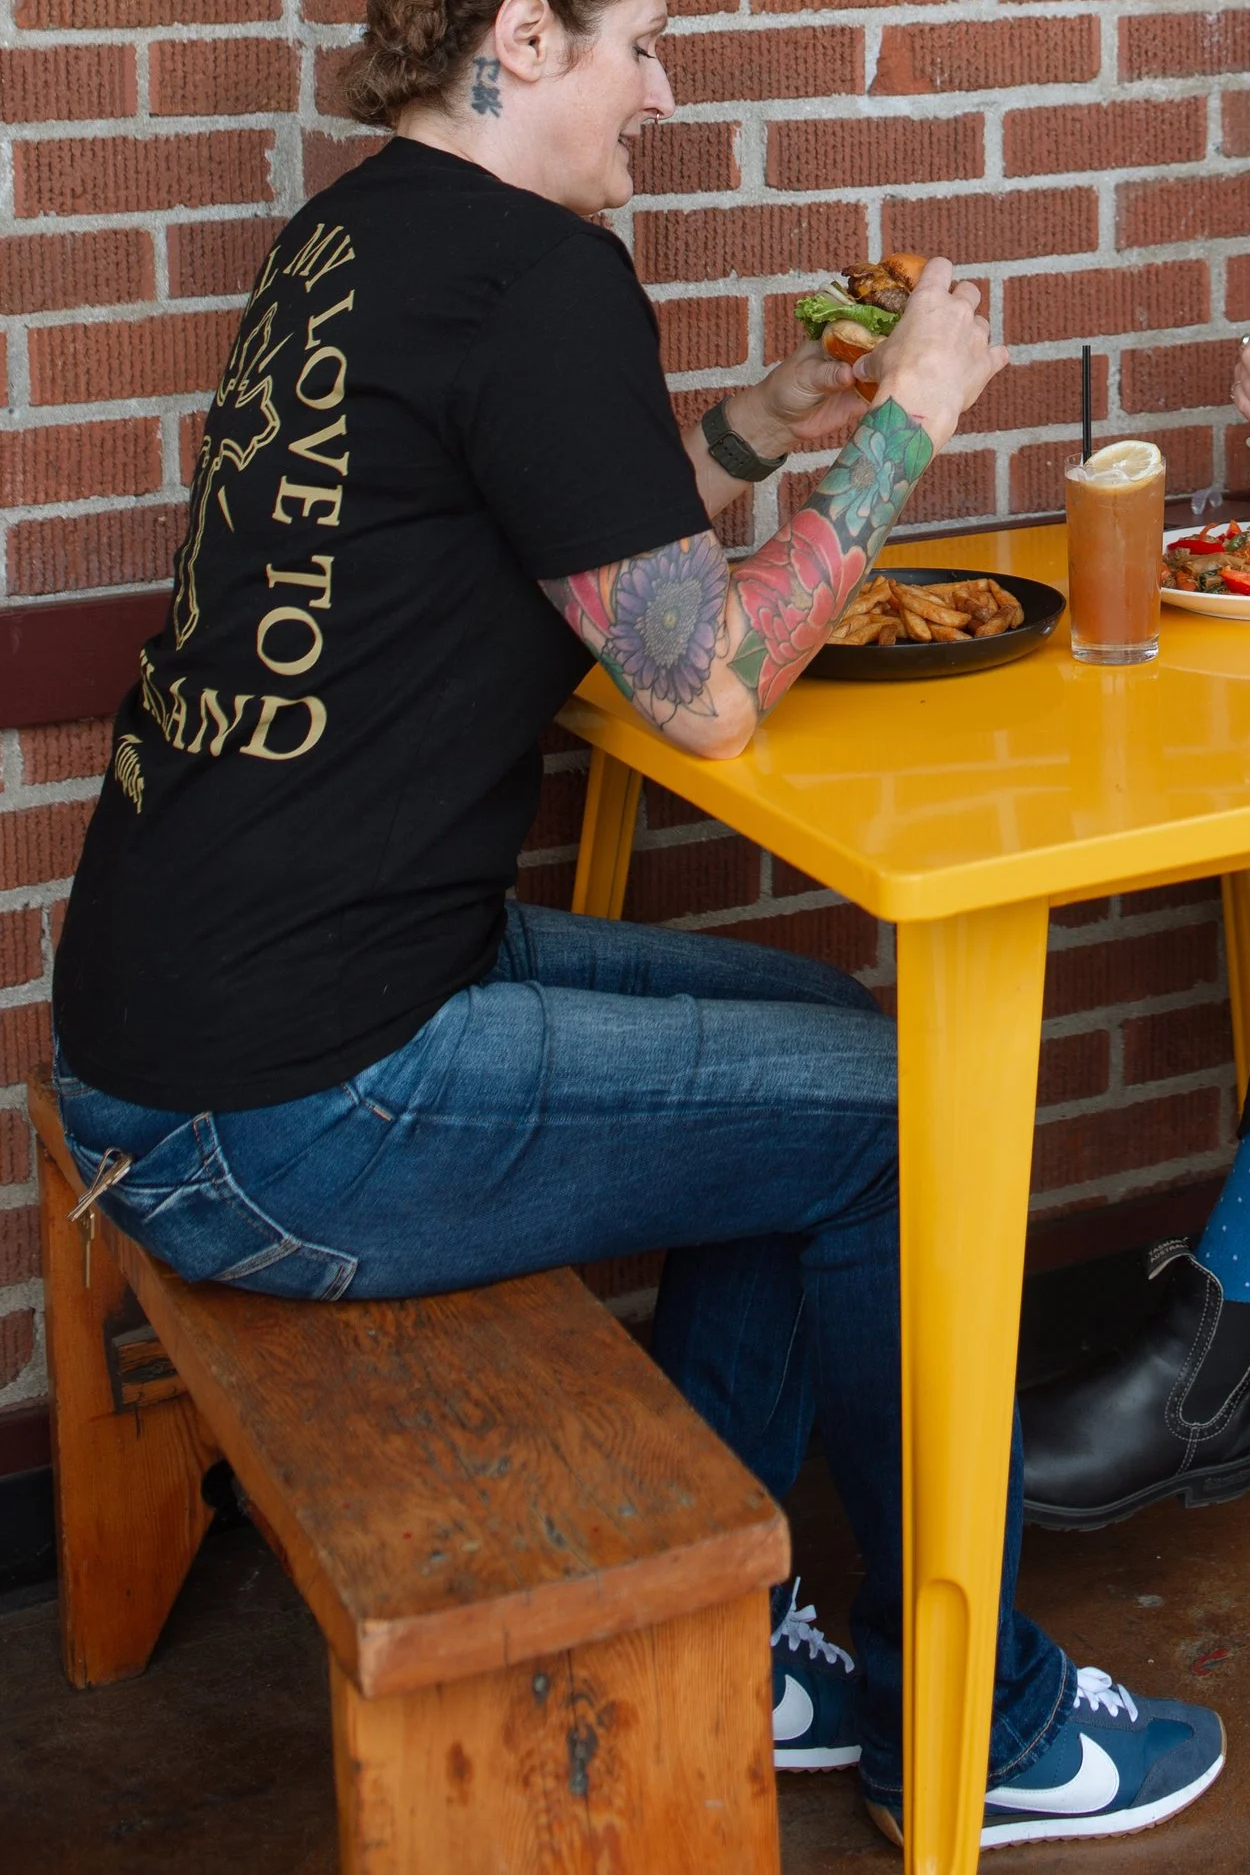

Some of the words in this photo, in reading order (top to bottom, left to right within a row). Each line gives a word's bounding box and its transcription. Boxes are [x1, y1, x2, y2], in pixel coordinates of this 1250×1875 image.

[282, 223, 356, 294] MY
[273, 288, 356, 527] LOVE
[256, 554, 335, 676] TO
